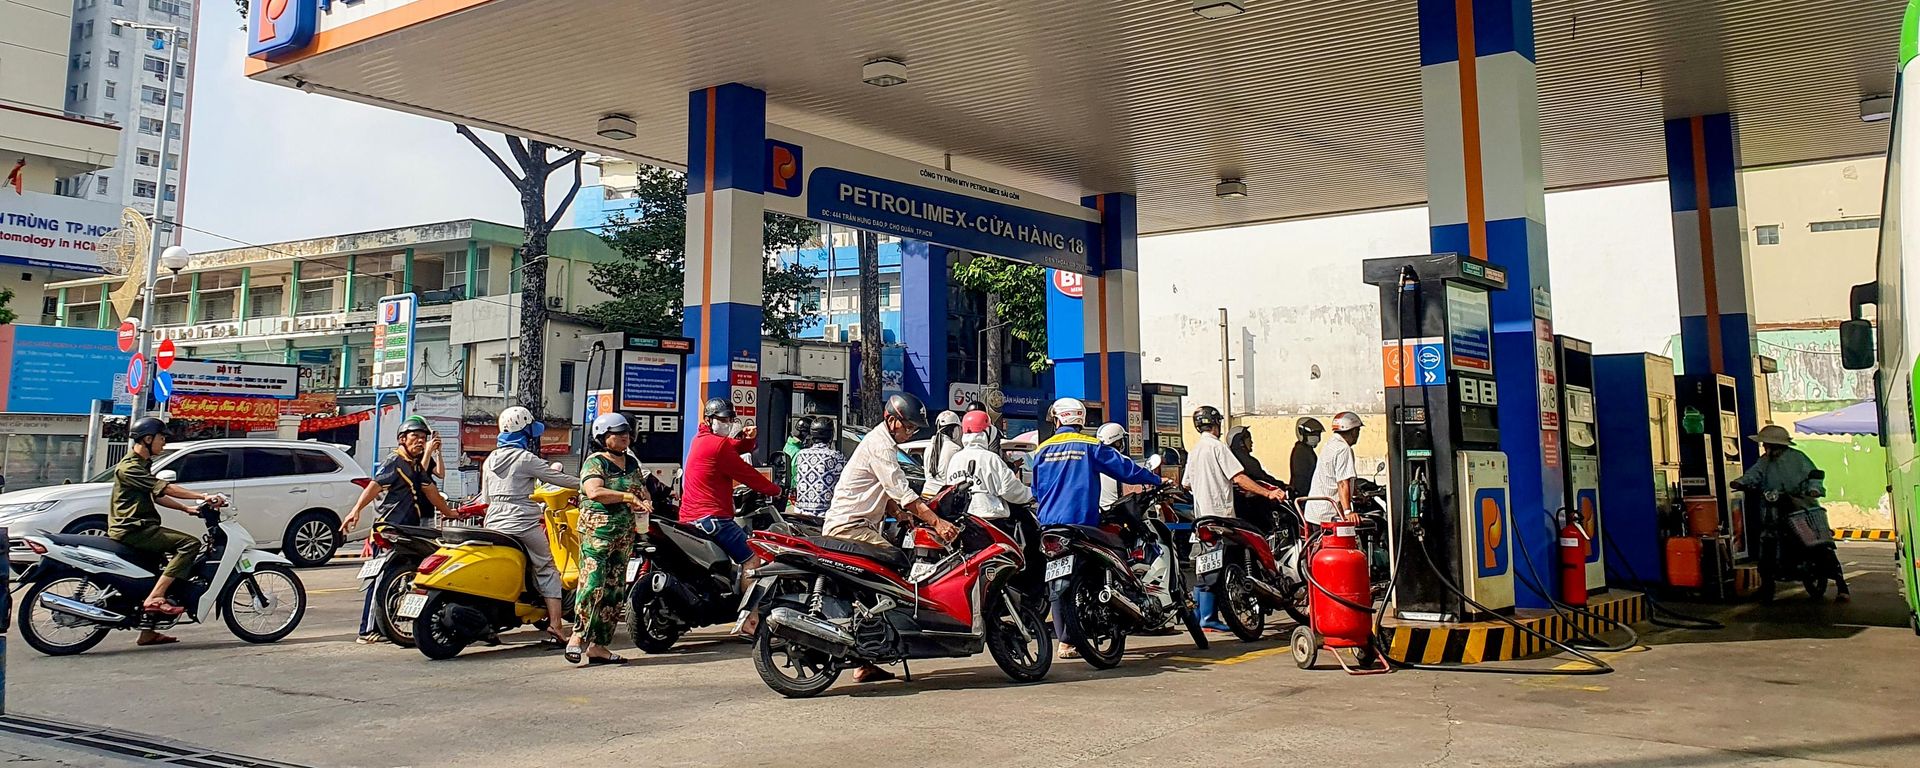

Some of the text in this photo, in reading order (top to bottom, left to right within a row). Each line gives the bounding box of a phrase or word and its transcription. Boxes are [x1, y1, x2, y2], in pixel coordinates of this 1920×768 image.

[919, 168, 936, 179] CÔNG
[936, 173, 944, 181] TY
[7, 212, 59, 231] TRÙNG
[65, 221, 118, 238] TP.HC
[1018, 225, 1065, 250] HÀNG
[1069, 237, 1084, 254] 18
